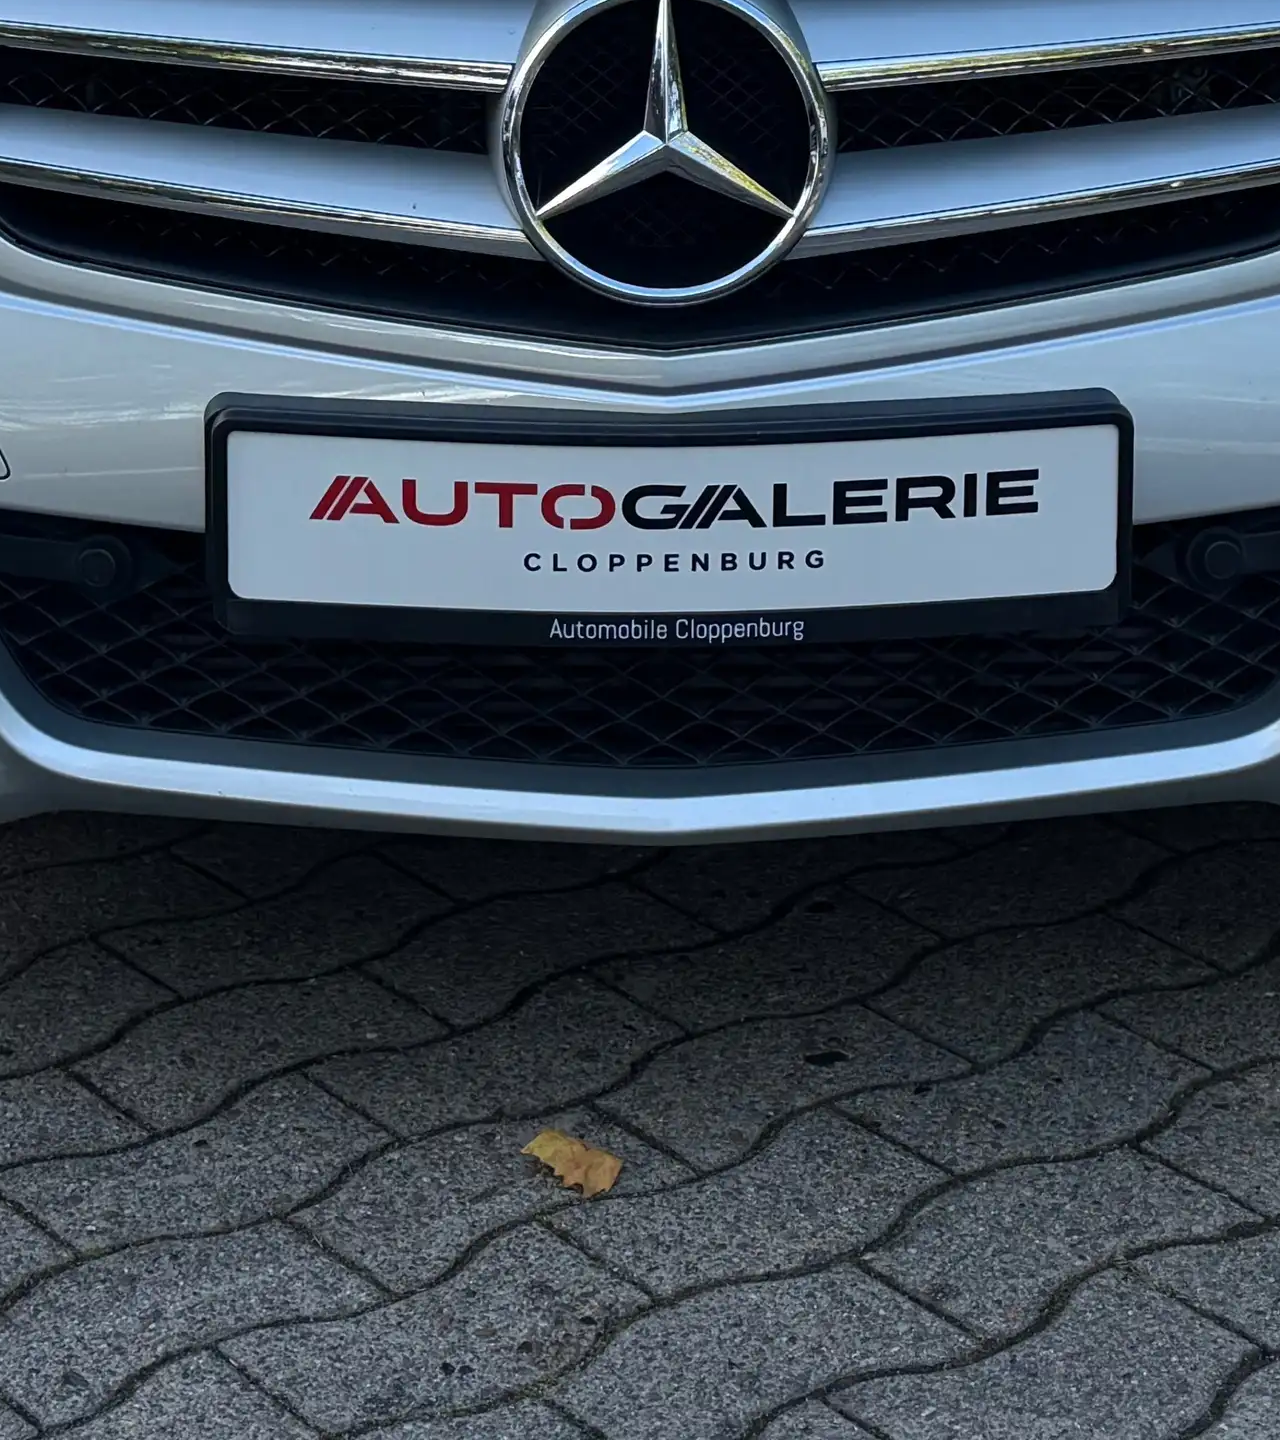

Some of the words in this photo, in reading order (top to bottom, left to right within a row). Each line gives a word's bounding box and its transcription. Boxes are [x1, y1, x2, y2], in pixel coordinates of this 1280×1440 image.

[309, 468, 1040, 530] AUTOGALERIE
[523, 550, 825, 573] CLOPPENBURG
[549, 618, 668, 640] Automobile
[675, 617, 805, 644] Cloppenburg
